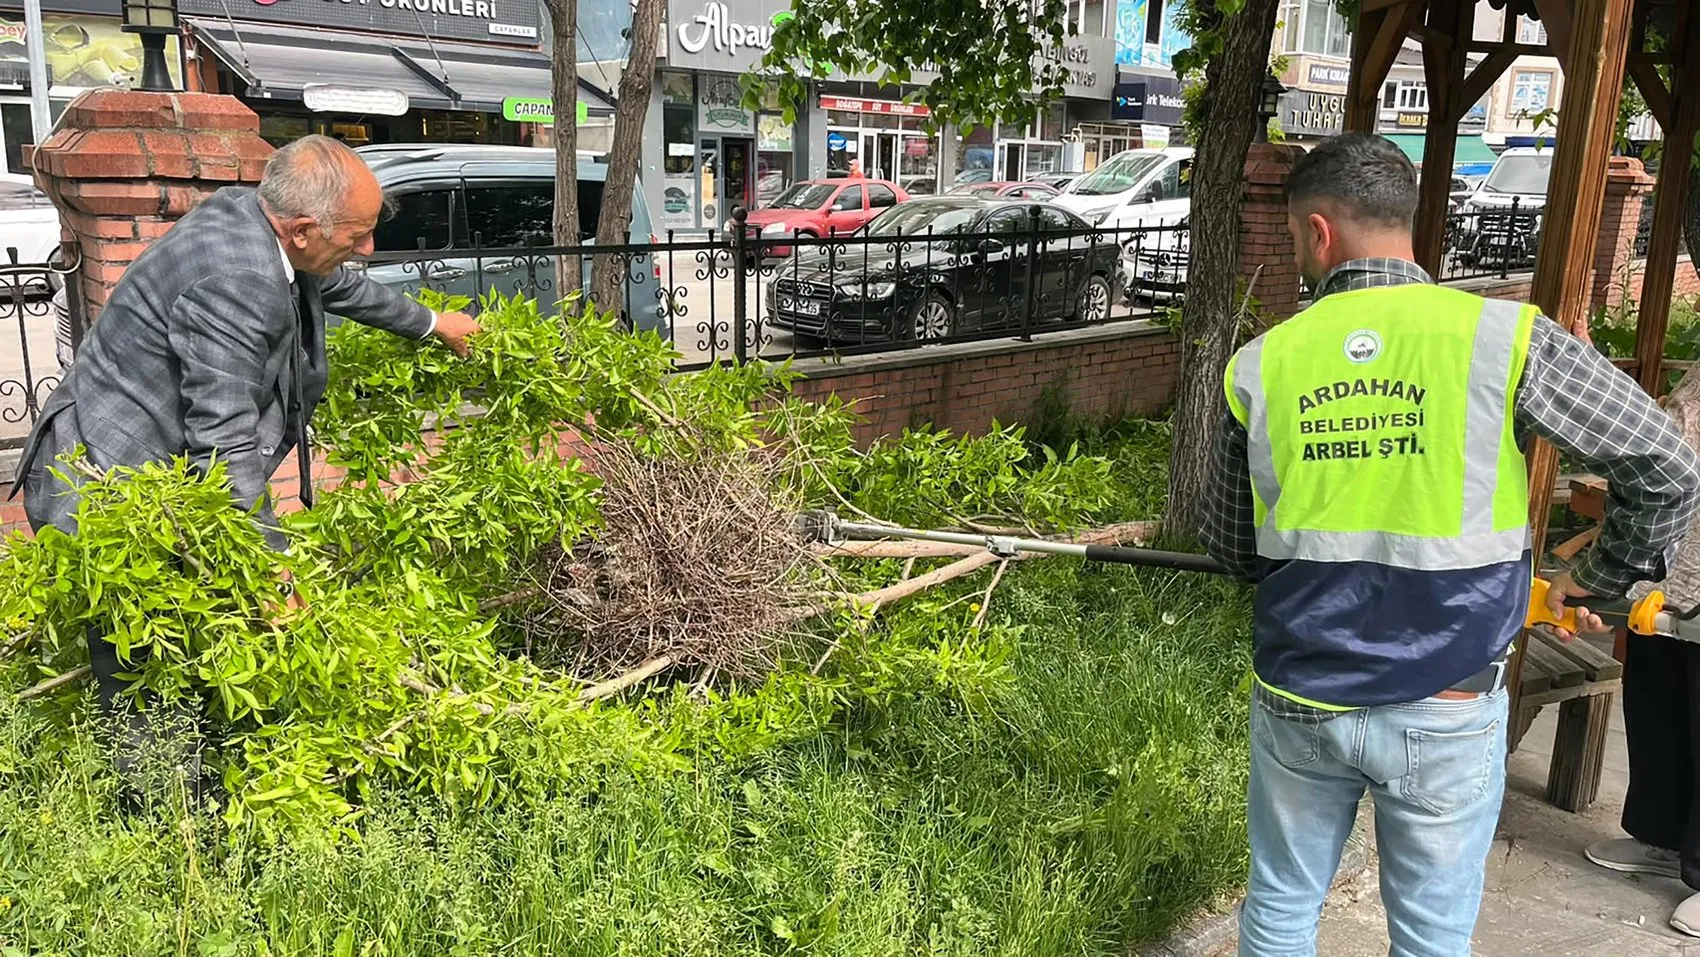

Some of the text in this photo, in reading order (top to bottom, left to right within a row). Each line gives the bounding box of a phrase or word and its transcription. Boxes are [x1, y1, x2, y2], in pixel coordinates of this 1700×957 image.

[1298, 378, 1426, 415] ARDAHAN
[1300, 408, 1424, 434] BELEDİYESİ
[1302, 432, 1425, 461] ARBEL ŞTİ.
